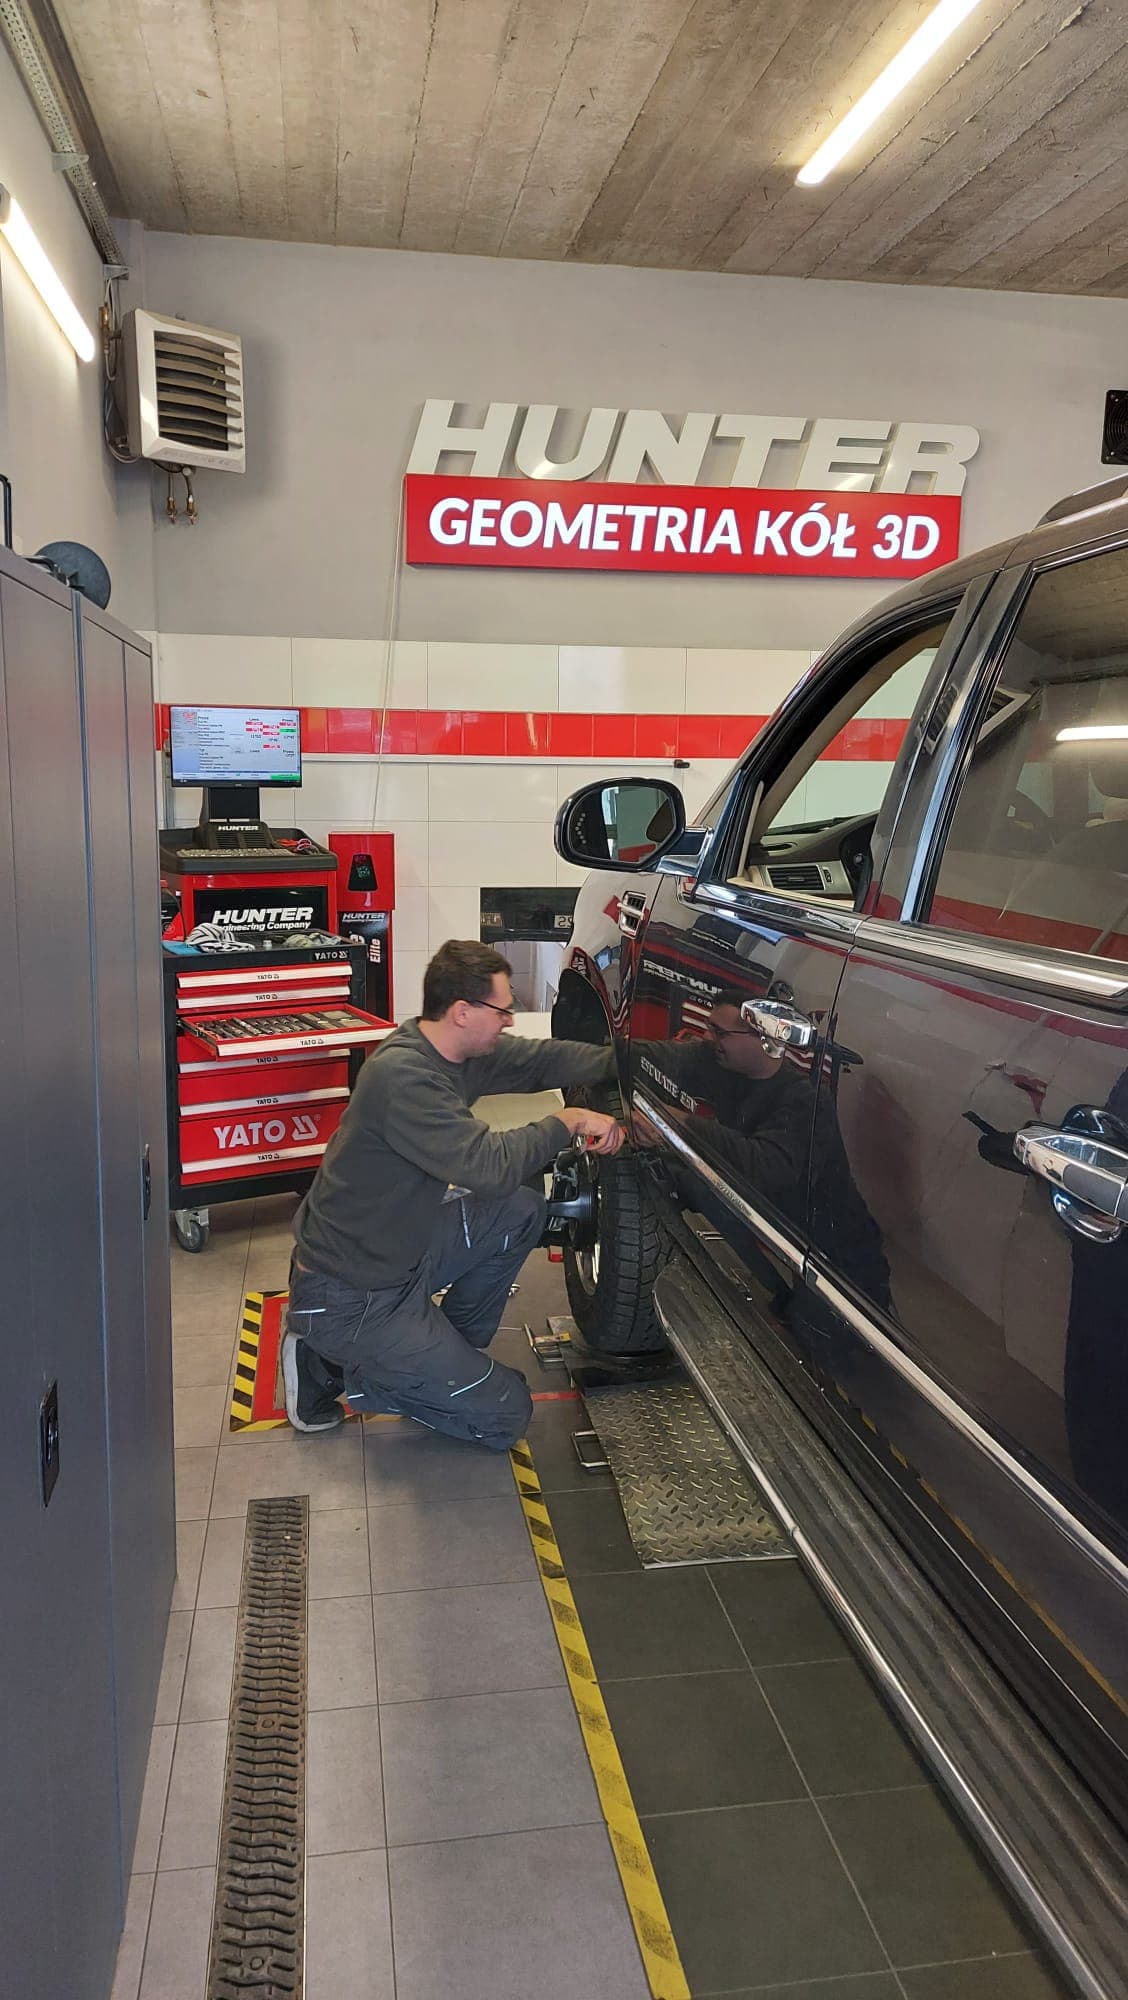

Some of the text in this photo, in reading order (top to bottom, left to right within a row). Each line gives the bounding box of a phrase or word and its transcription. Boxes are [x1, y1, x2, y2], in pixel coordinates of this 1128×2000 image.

[406, 398, 980, 496] HUNTER
[428, 496, 941, 560] GEOMETRIA KÓŁ 3D
[212, 906, 314, 924] HUNTER
[342, 912, 386, 921] HUNTER
[266, 921, 312, 931] Company
[315, 951, 338, 960] YATO
[369, 938, 382, 963] Elite
[301, 1037, 317, 1046] YATO
[256, 1056, 272, 1064] YATO
[213, 1119, 286, 1150] YATO
[258, 1153, 273, 1161] YATO
